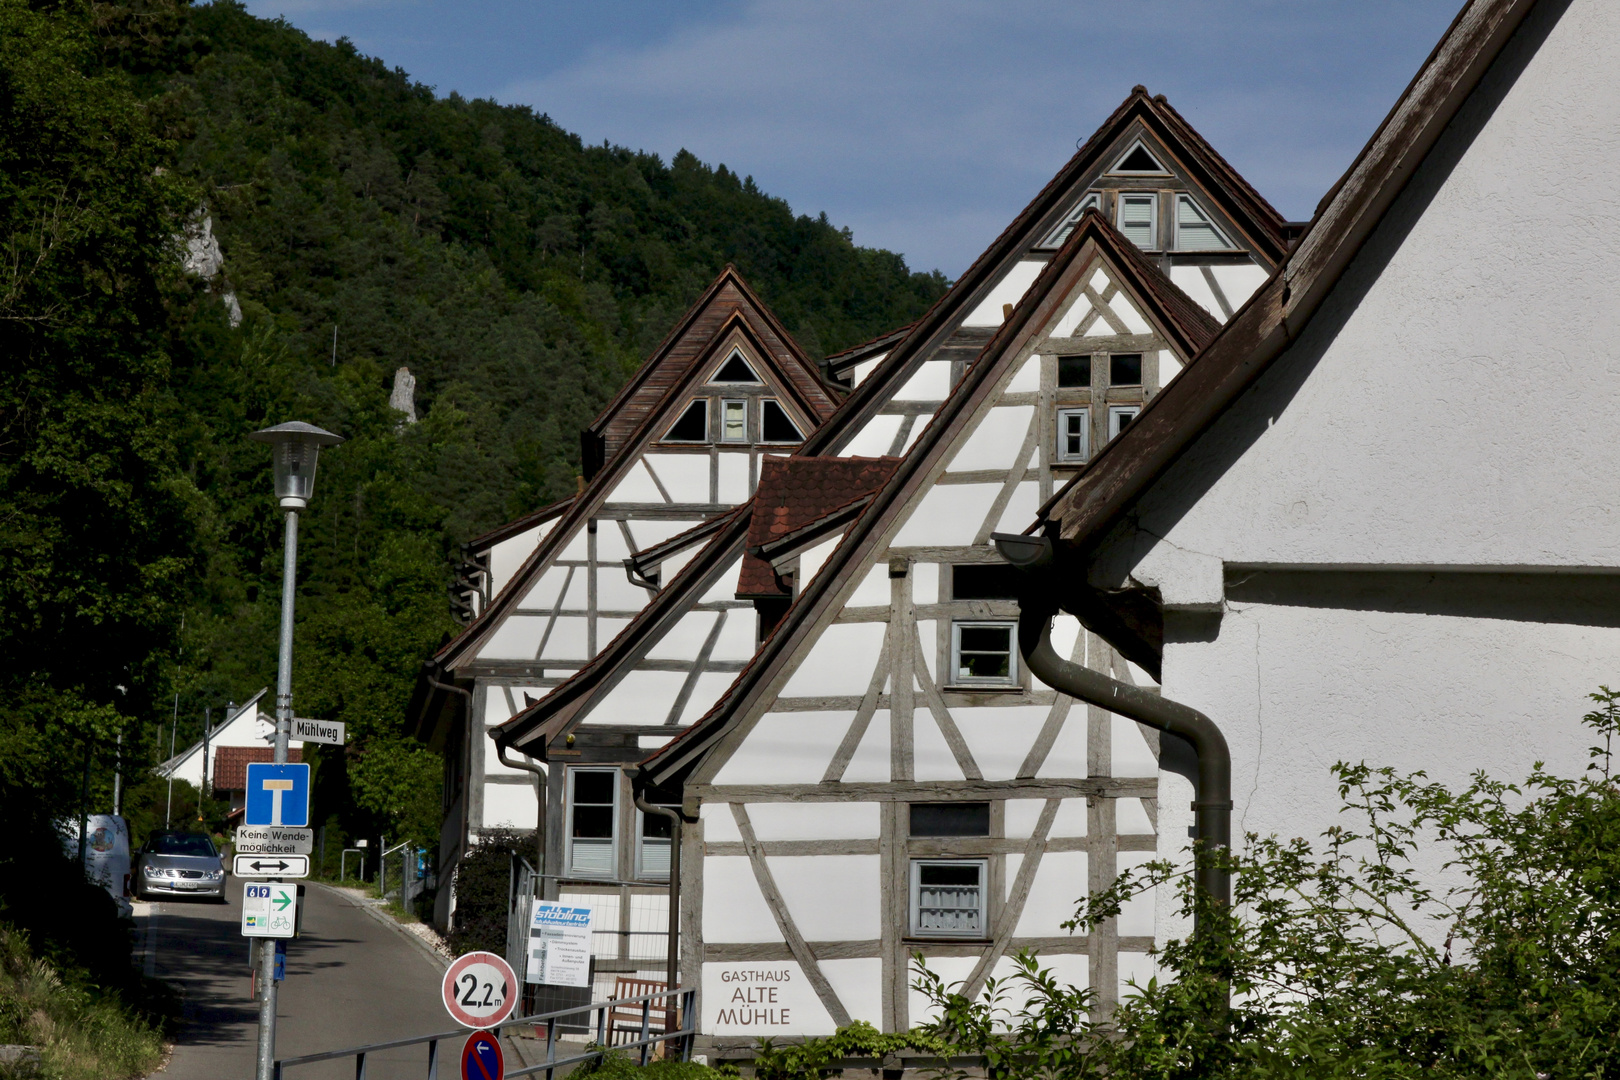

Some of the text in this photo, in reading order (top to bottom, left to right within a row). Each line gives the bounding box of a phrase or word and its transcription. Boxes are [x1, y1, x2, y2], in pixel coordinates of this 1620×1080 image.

[296, 721, 338, 742] Mühlweg
[240, 829, 309, 841] Keine Wende-
[240, 843, 296, 854] möglichkeit
[249, 888, 267, 898] 6 9
[721, 970, 791, 982] GASTHAUS
[730, 986, 778, 1003] ALTE
[716, 1004, 791, 1025] MÜHLE
